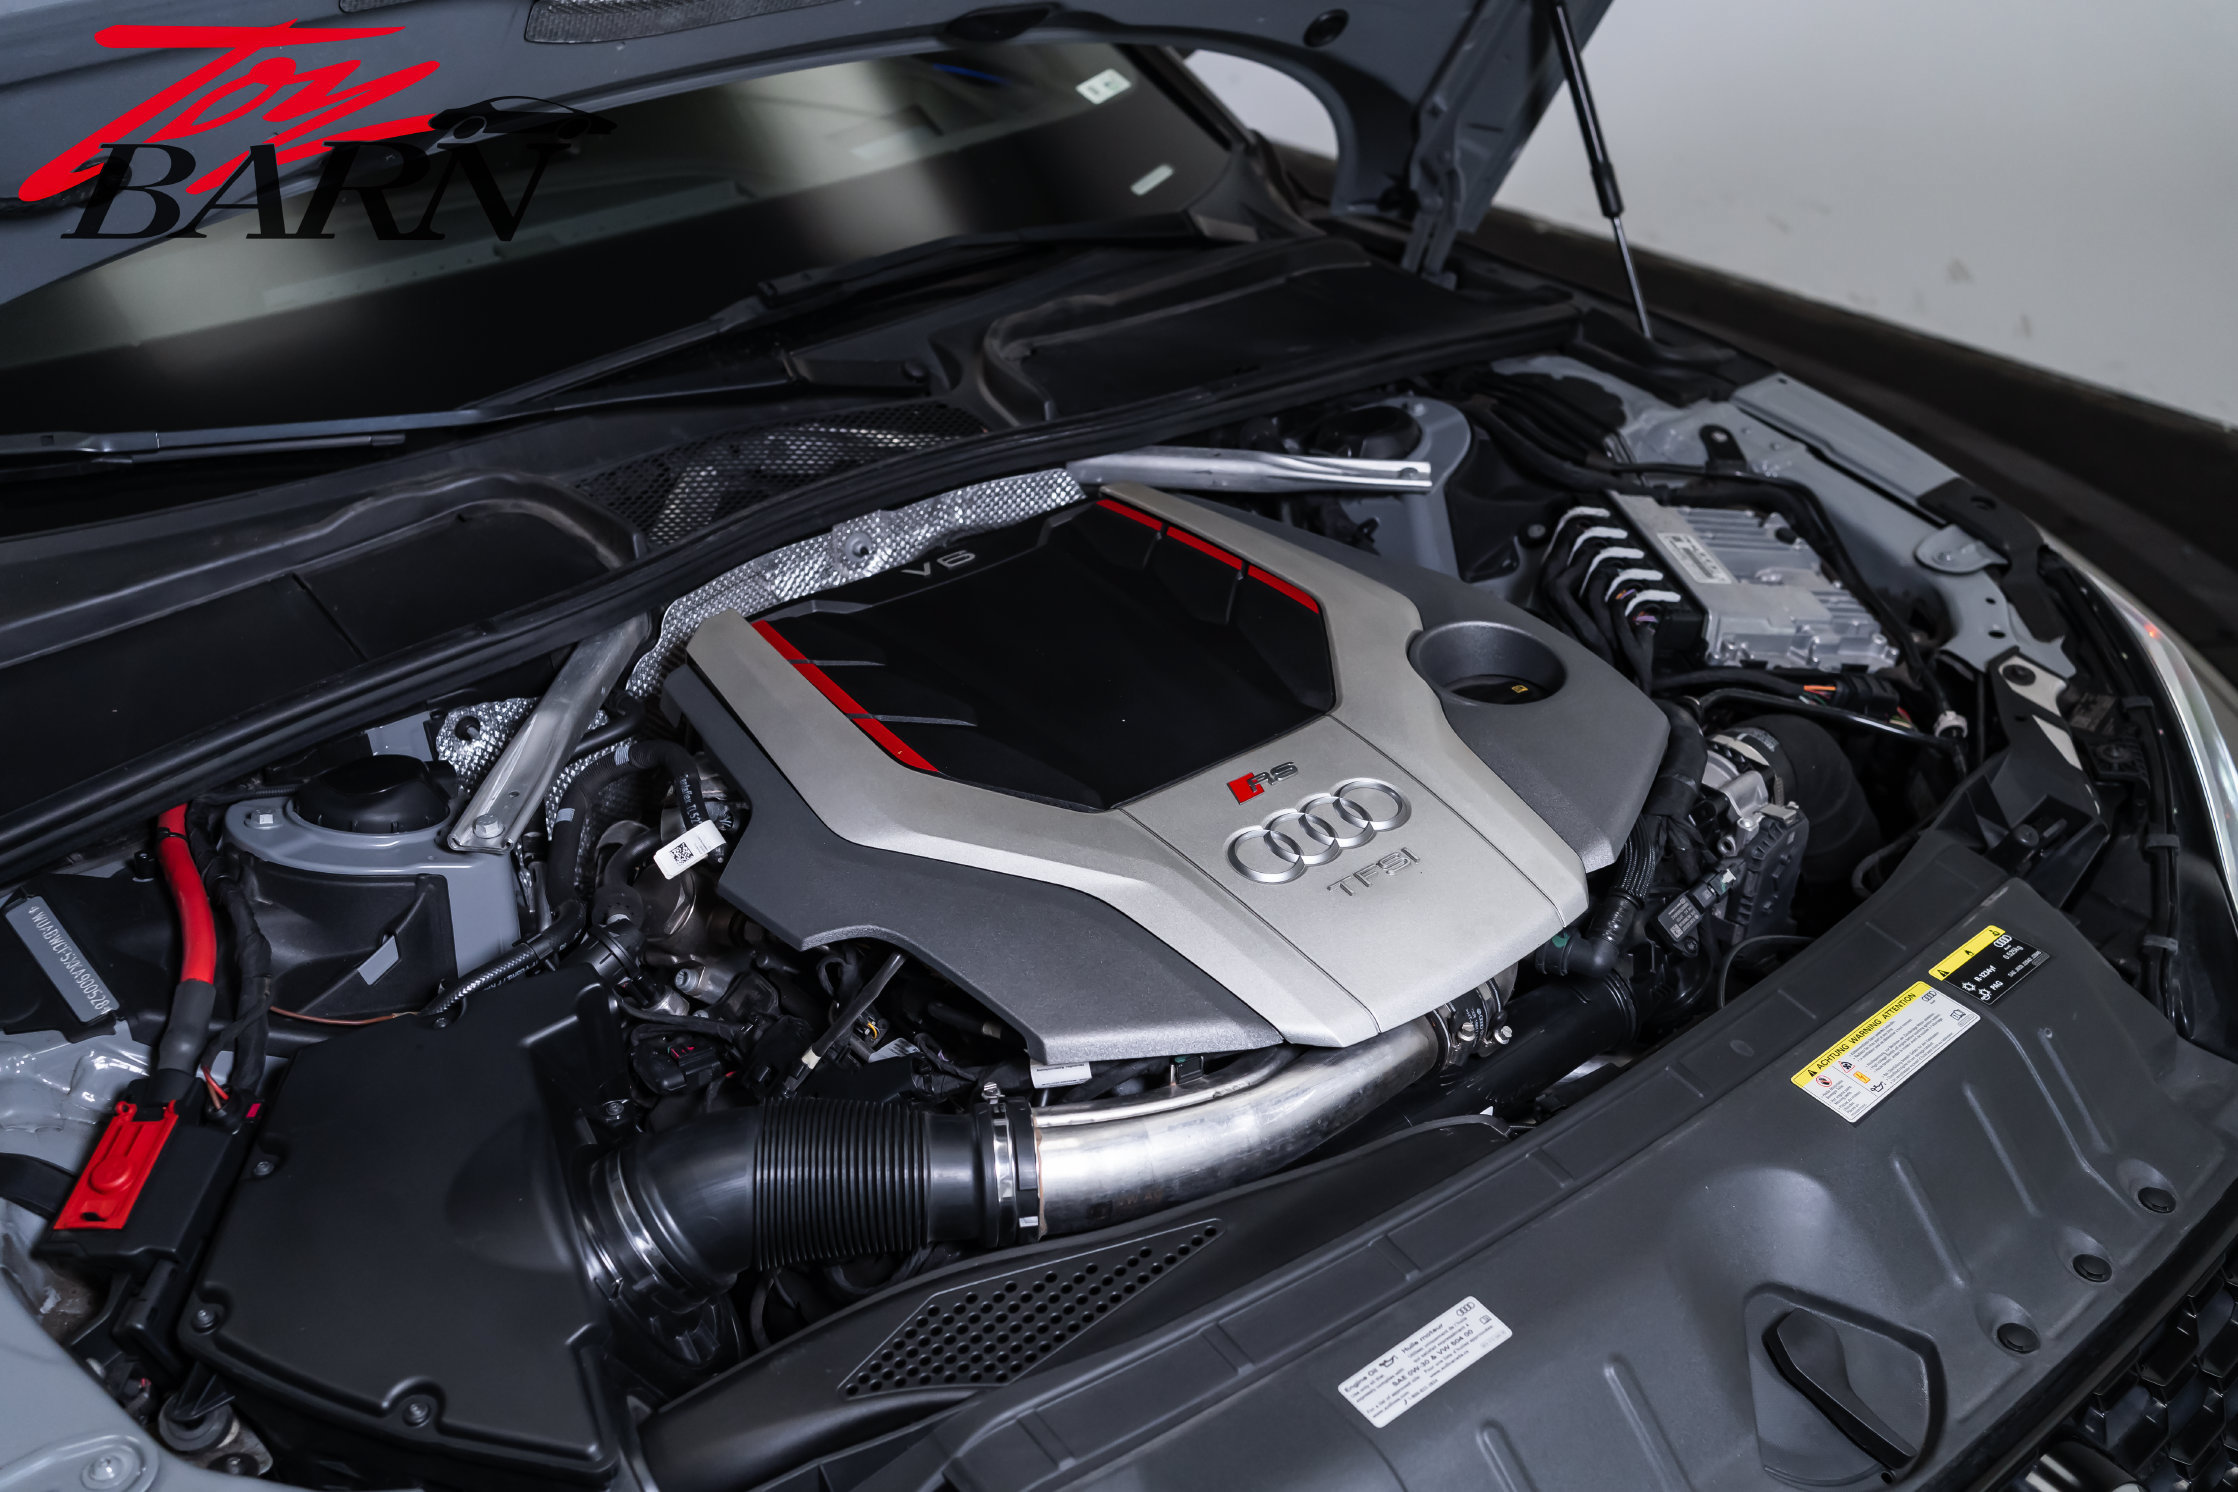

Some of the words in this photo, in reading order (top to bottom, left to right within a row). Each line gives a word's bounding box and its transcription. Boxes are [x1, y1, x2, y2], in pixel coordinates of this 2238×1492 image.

[901, 550, 976, 577] V6
[1246, 761, 1298, 793] RS
[1327, 847, 1420, 896] TFSI
[1989, 980, 2004, 991] PAG
[1815, 1044, 1849, 1068] ACHTUNG
[1849, 1019, 1881, 1043] WARNING
[1881, 993, 1916, 1018] ATTENTION
[1401, 1340, 1418, 1352] Huile
[1419, 1323, 1443, 1341] moteur
[1392, 1375, 1406, 1385] SAE
[1437, 1345, 1450, 1354] VW
[1344, 1375, 1367, 1392] Engine
